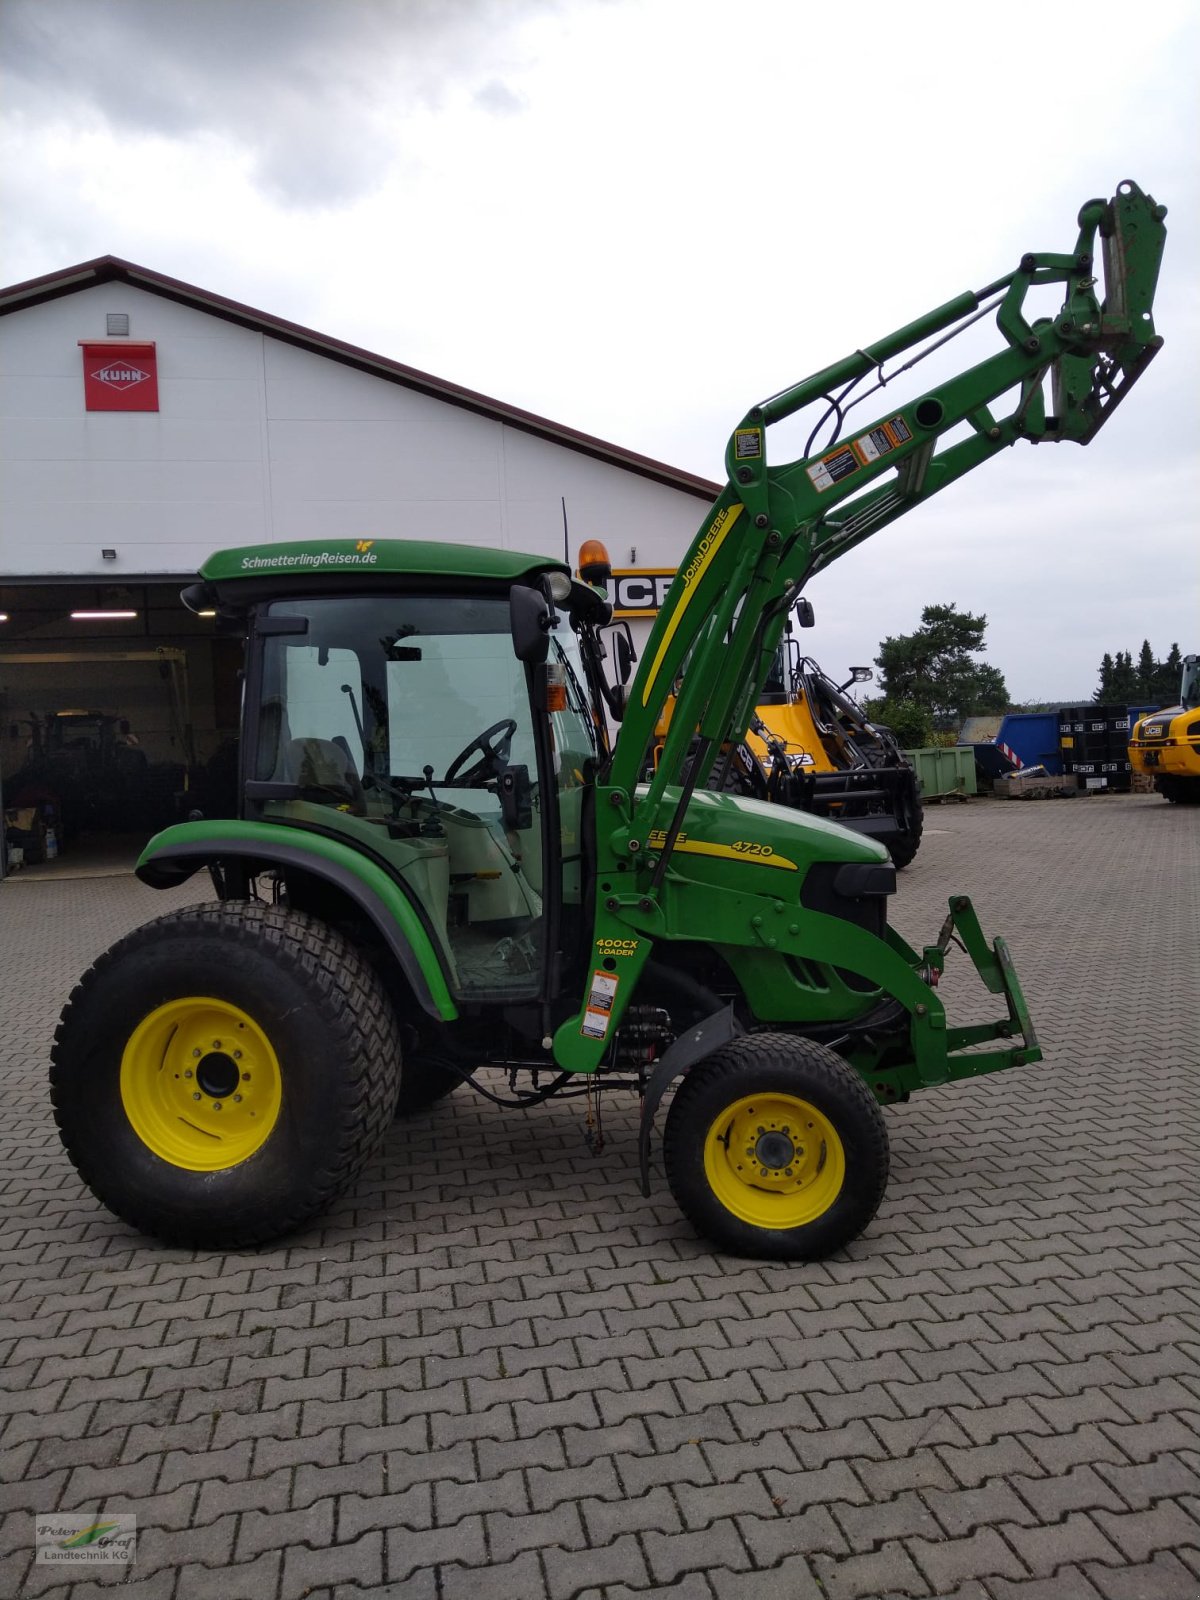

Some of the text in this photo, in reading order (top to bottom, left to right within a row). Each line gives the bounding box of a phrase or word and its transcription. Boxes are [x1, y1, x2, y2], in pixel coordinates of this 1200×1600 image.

[100, 370, 141, 381] KUHN
[682, 508, 728, 587] JOHN DEERE
[241, 552, 377, 569] SchmetterlingReisen.de
[731, 841, 773, 856] 4720
[596, 939, 639, 949] 400CX
[598, 948, 635, 957] LOADER
